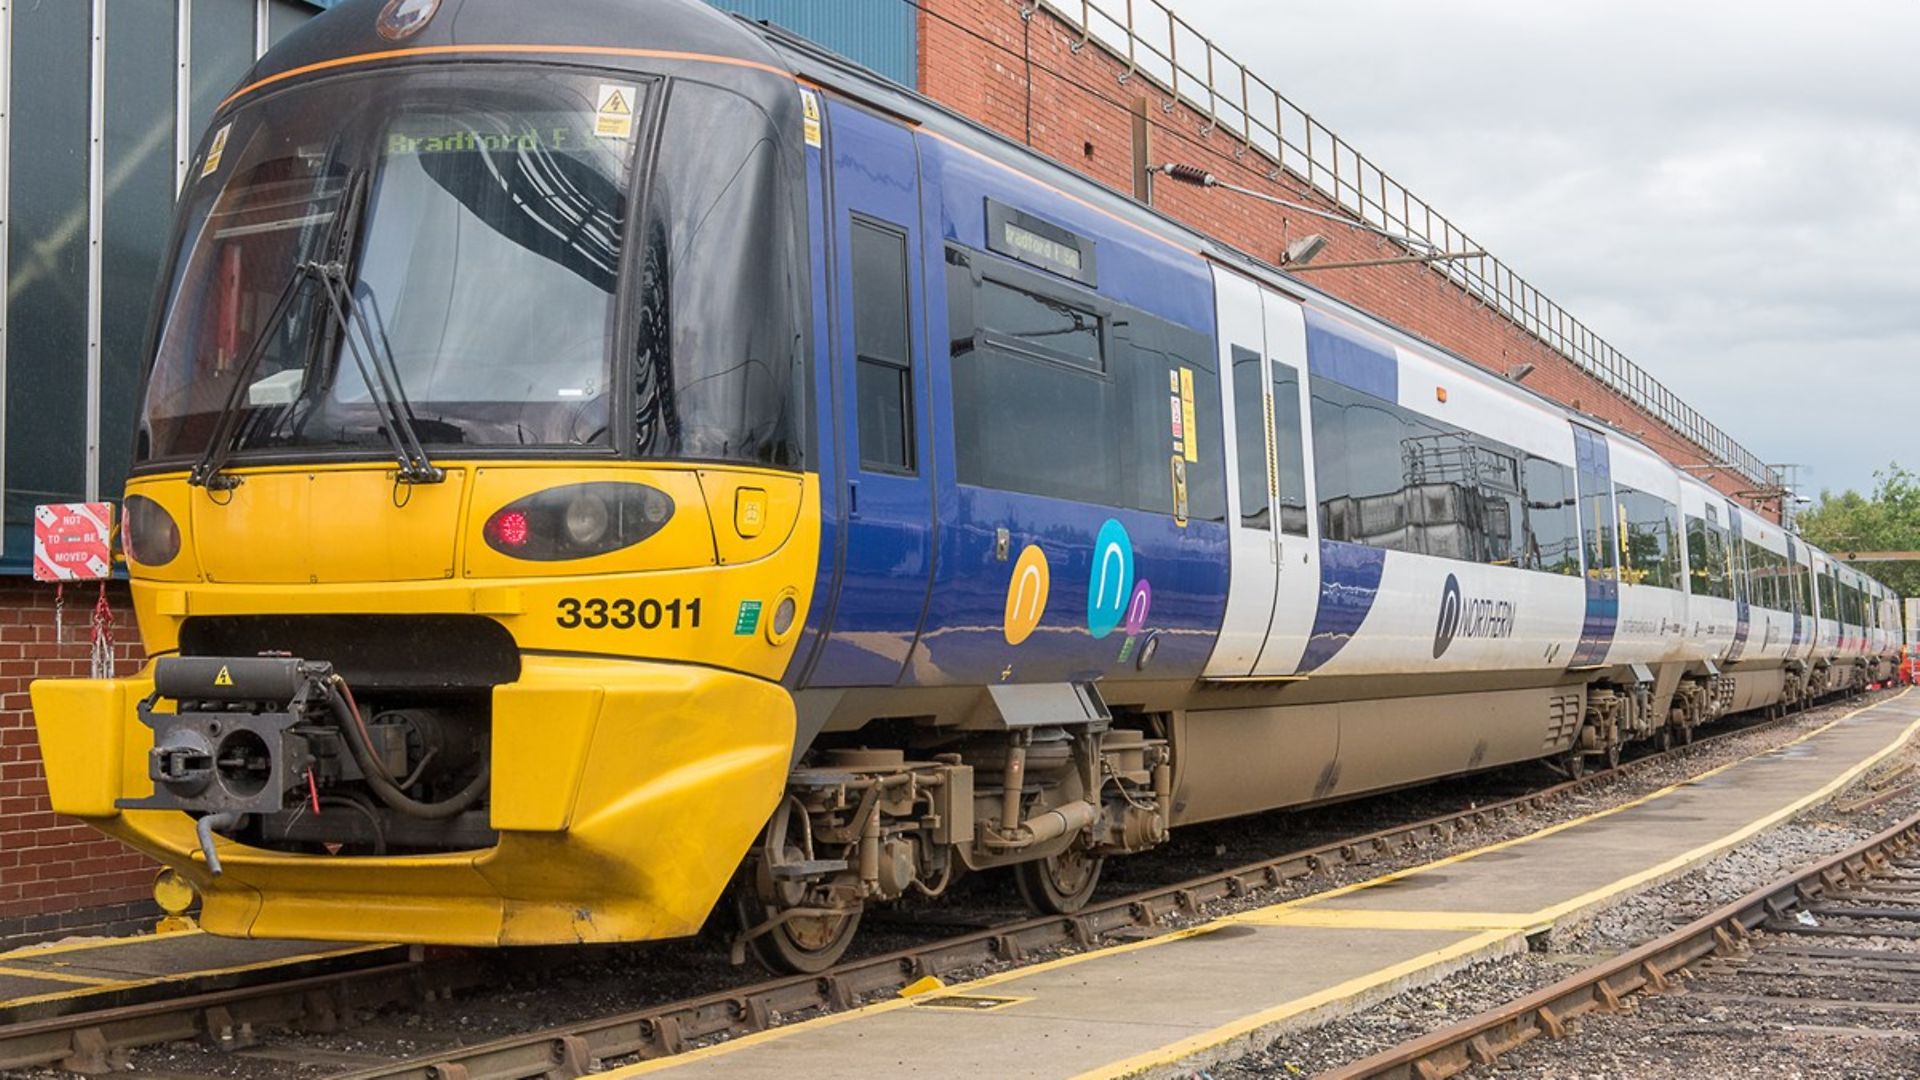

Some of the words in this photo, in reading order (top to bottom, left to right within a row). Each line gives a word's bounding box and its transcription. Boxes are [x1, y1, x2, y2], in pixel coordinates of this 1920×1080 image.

[388, 129, 537, 153] Bradford
[63, 516, 81, 526] NOT
[47, 534, 60, 544] TO
[83, 533, 97, 543] BE
[54, 551, 89, 562] MOVED
[556, 597, 702, 630] 333011
[1457, 598, 1517, 639] NORTHERN
